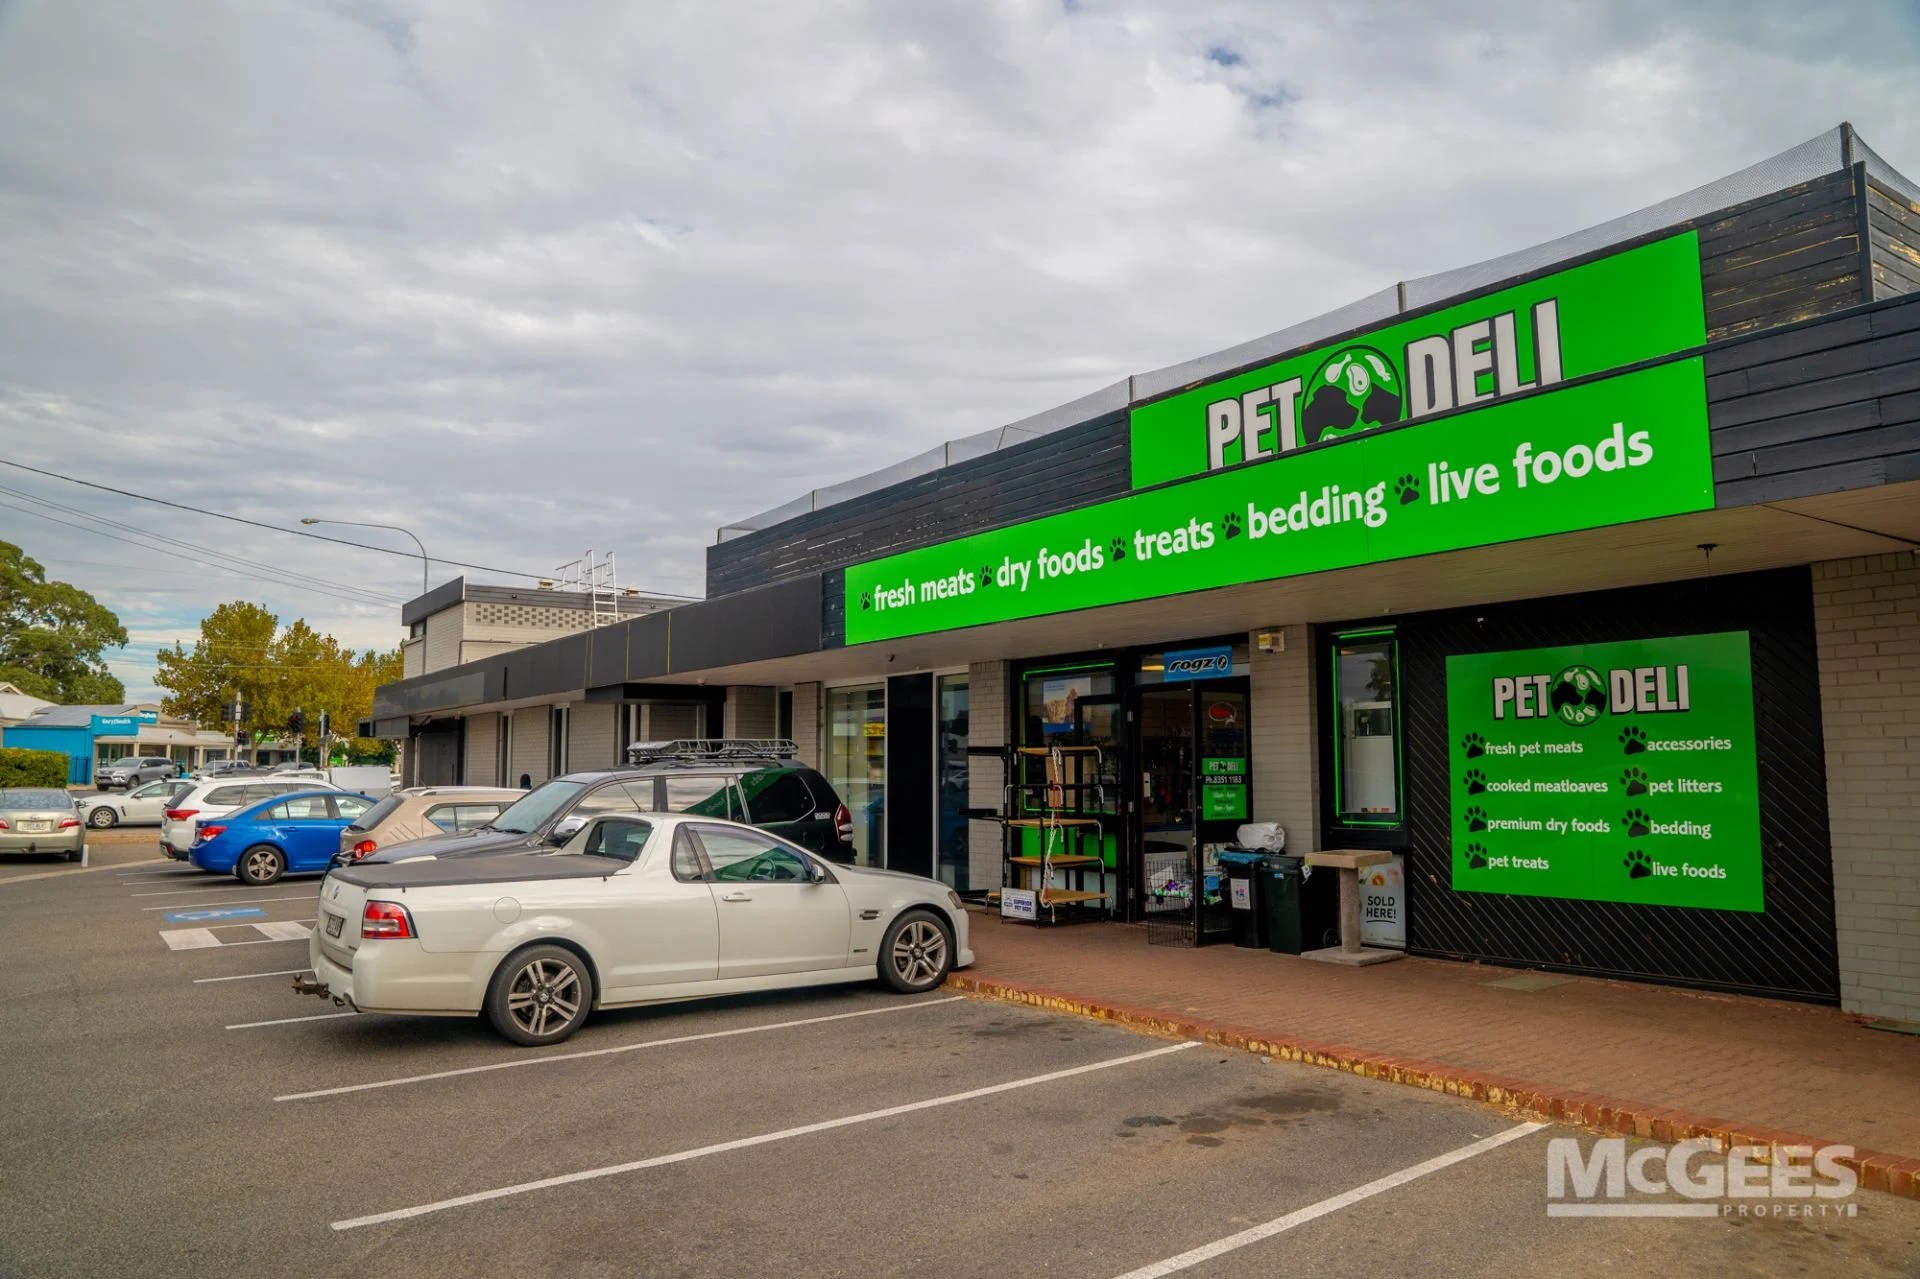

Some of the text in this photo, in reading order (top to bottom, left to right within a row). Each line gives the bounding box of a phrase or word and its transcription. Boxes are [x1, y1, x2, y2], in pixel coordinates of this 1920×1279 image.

[1207, 298, 1561, 470] PET DELI
[873, 422, 1653, 611] fresh meats dry foods treats bedding live foods
[1168, 657, 1217, 673] rogz
[1493, 664, 1690, 719] PET DELI
[1484, 741, 1584, 758] fresh pet meats
[1647, 736, 1732, 751] accessories
[1486, 778, 1609, 793] cooked meatloaves
[1649, 778, 1723, 797] pet litters
[1487, 817, 1611, 835] premium dry foods
[1650, 819, 1712, 840] bedding
[1488, 855, 1550, 870] pet treats
[1652, 861, 1727, 880] live foods
[1367, 895, 1396, 907] SOLD
[1366, 907, 1397, 919] HERE!
